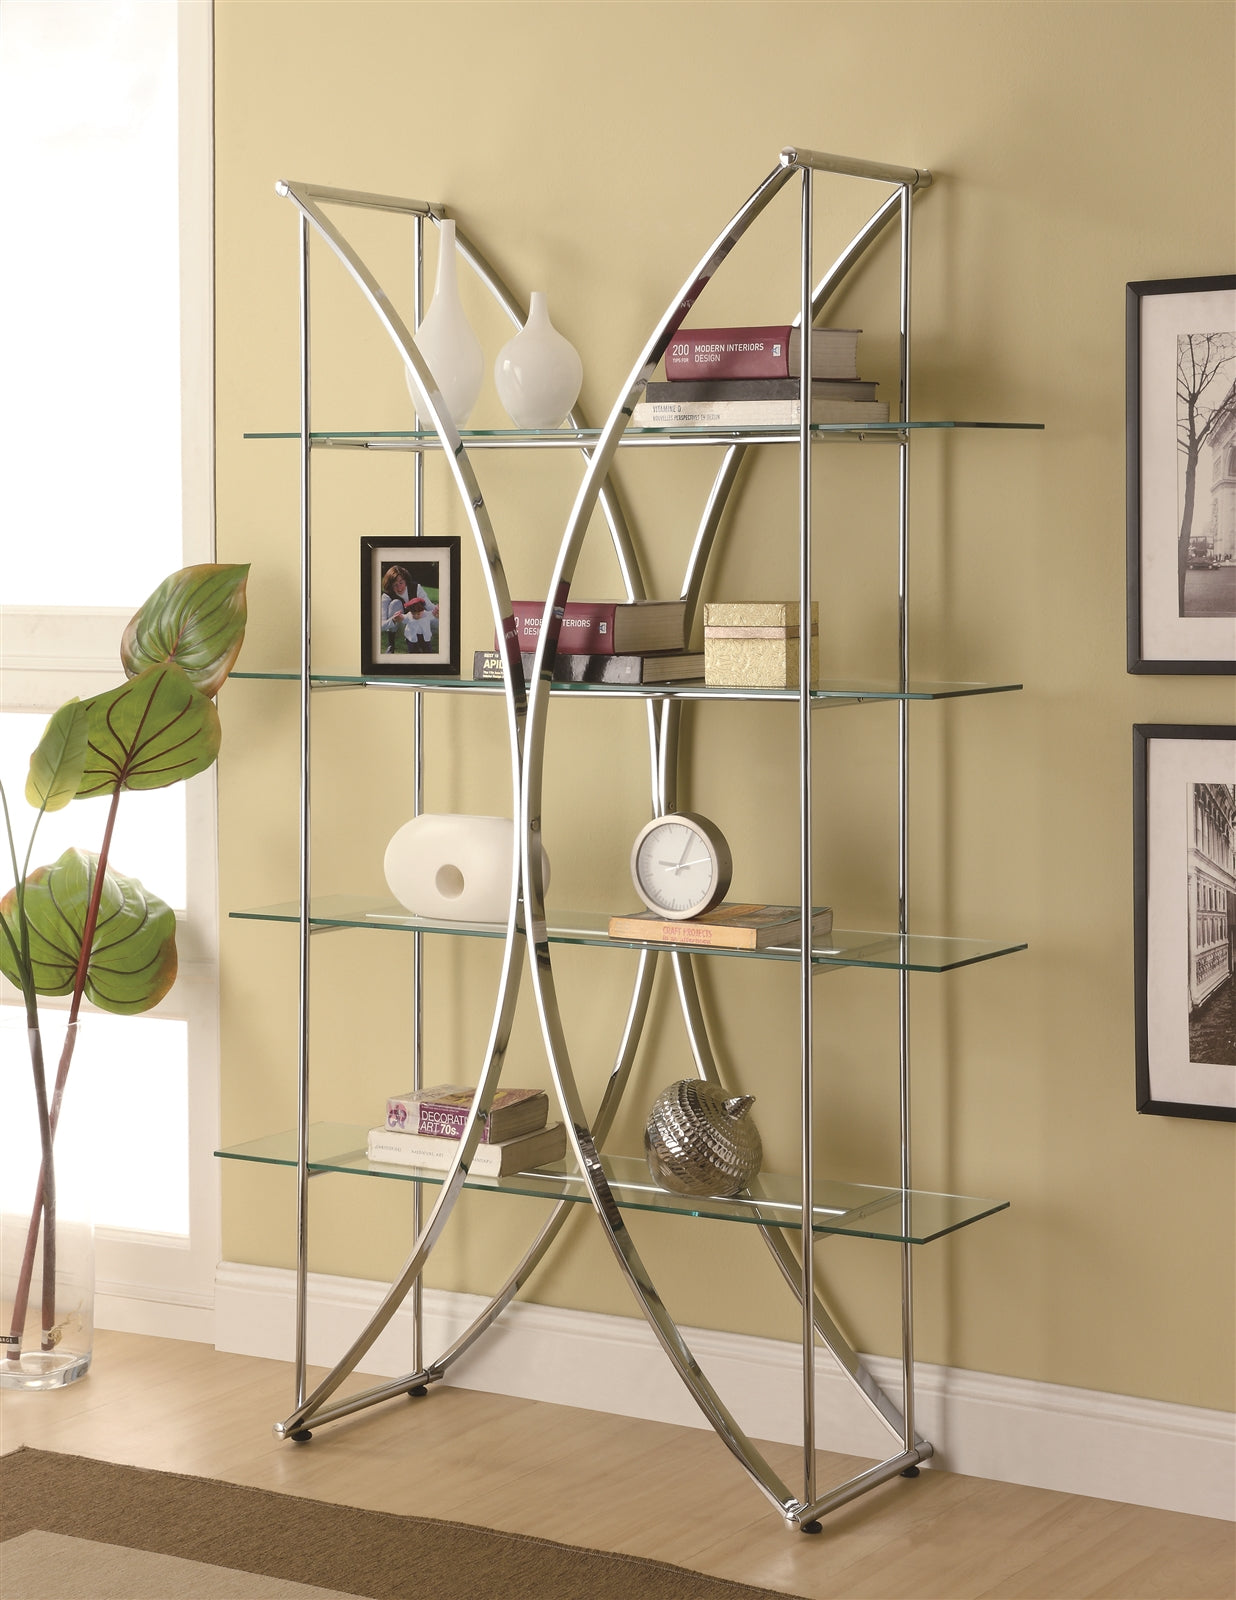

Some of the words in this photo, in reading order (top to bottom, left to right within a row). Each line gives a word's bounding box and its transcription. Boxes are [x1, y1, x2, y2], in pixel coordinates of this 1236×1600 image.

[672, 344, 690, 356] 200
[694, 344, 725, 352] MODERN
[726, 342, 764, 352] INTERIORS
[694, 354, 720, 362] DESIGN
[662, 926, 682, 934] CRAFT
[683, 928, 712, 937] PROJECTS
[420, 1121, 440, 1133] ART
